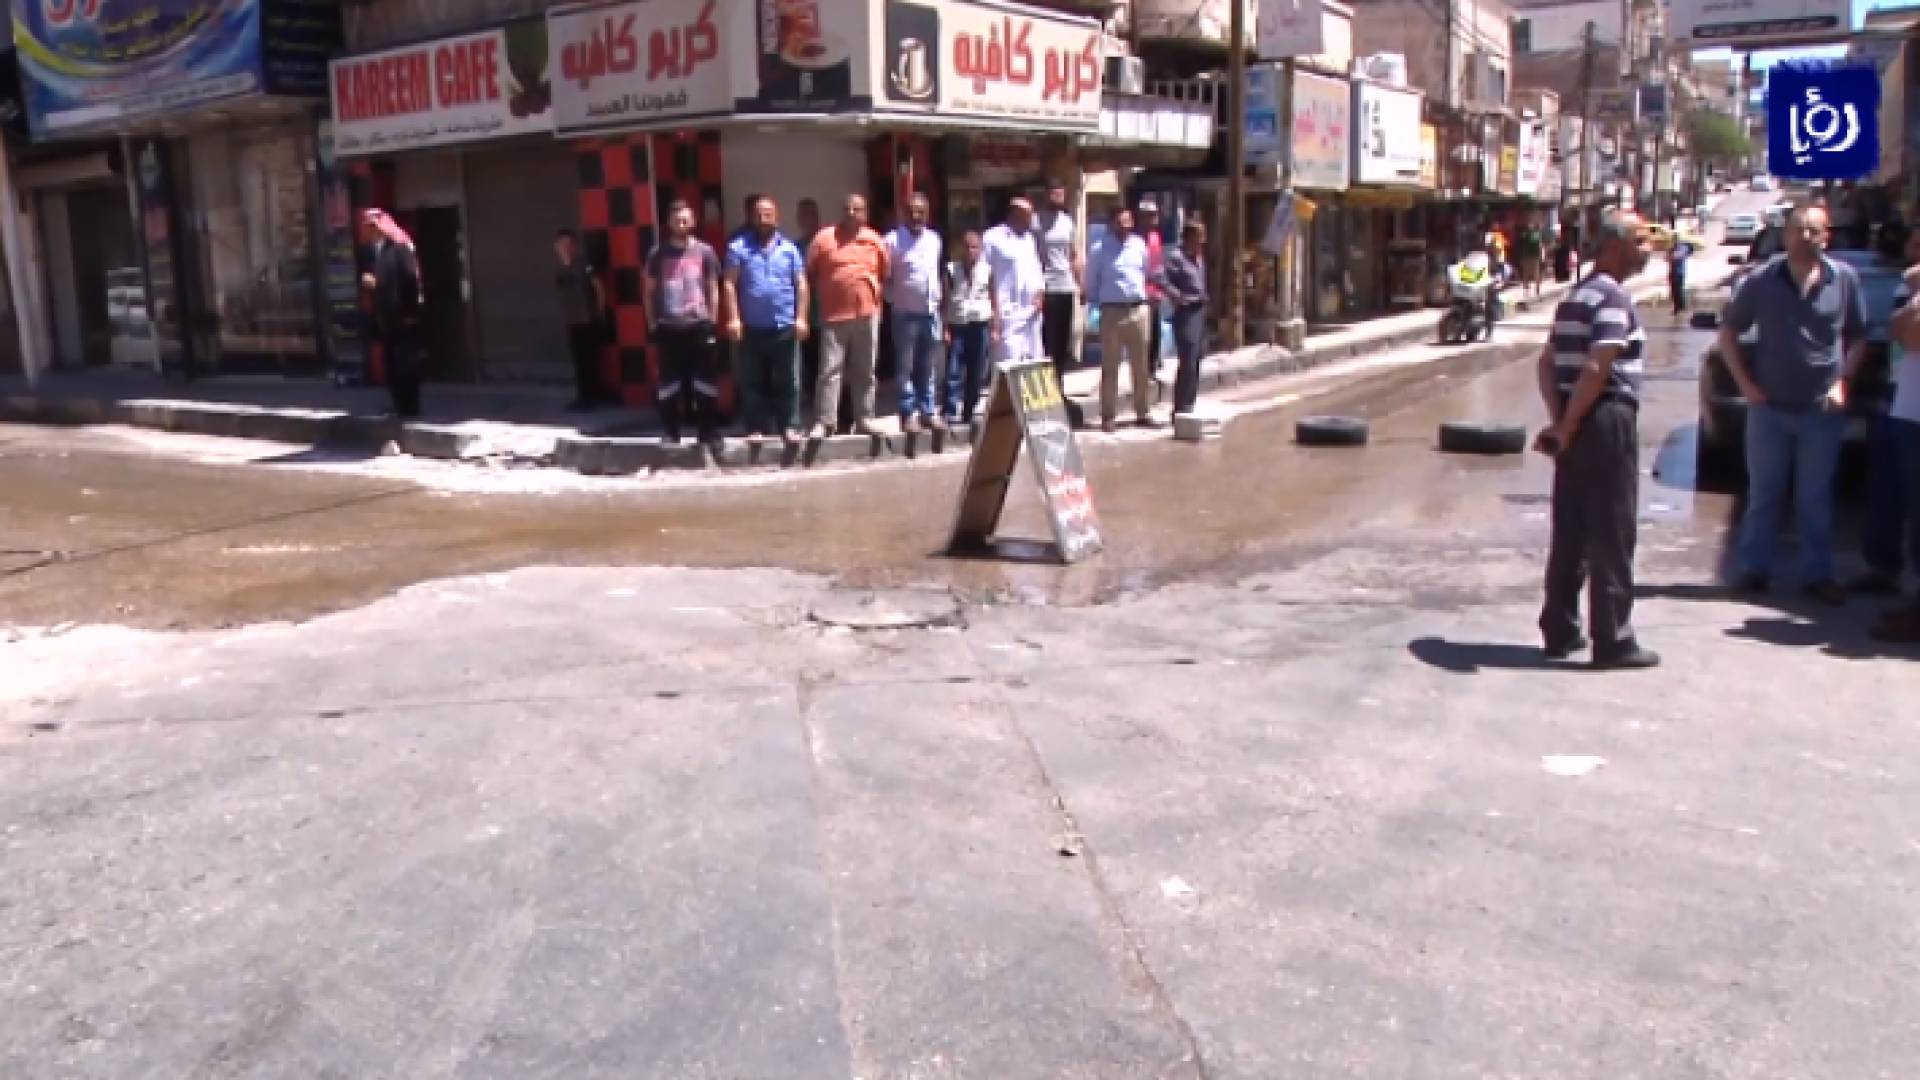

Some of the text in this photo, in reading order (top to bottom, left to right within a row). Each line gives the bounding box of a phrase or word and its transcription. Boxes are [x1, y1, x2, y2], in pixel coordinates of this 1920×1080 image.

[336, 52, 430, 122] KAREEM
[434, 38, 499, 108] CAFE
[561, 14, 638, 90] كافيه
[648, 0, 719, 81] كريم
[953, 15, 1098, 103] كريم كافيه
